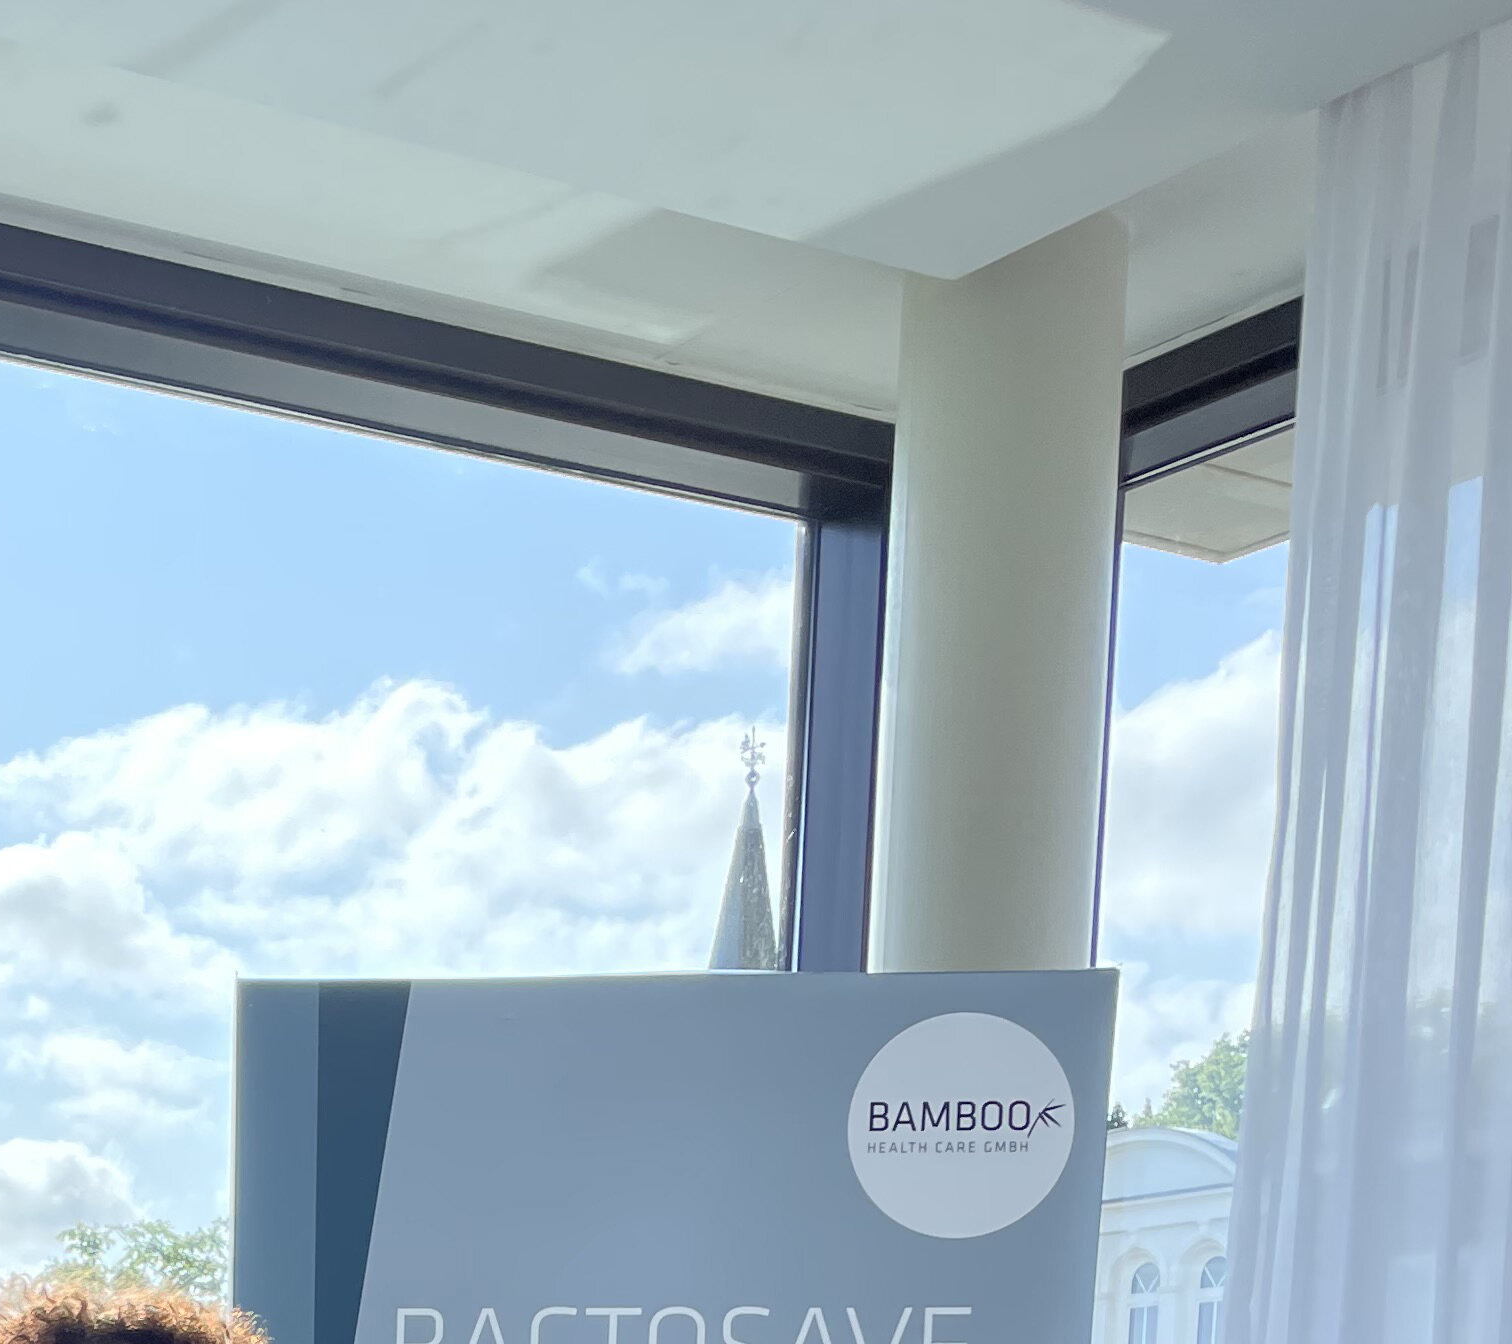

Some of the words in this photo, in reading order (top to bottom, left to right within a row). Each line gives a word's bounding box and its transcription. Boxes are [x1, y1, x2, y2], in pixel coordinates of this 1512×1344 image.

[867, 1099, 1032, 1133] BAMBOO
[867, 1140, 929, 1154] HEALTH
[934, 1140, 977, 1154] CARE
[983, 1139, 1031, 1154] GMBH
